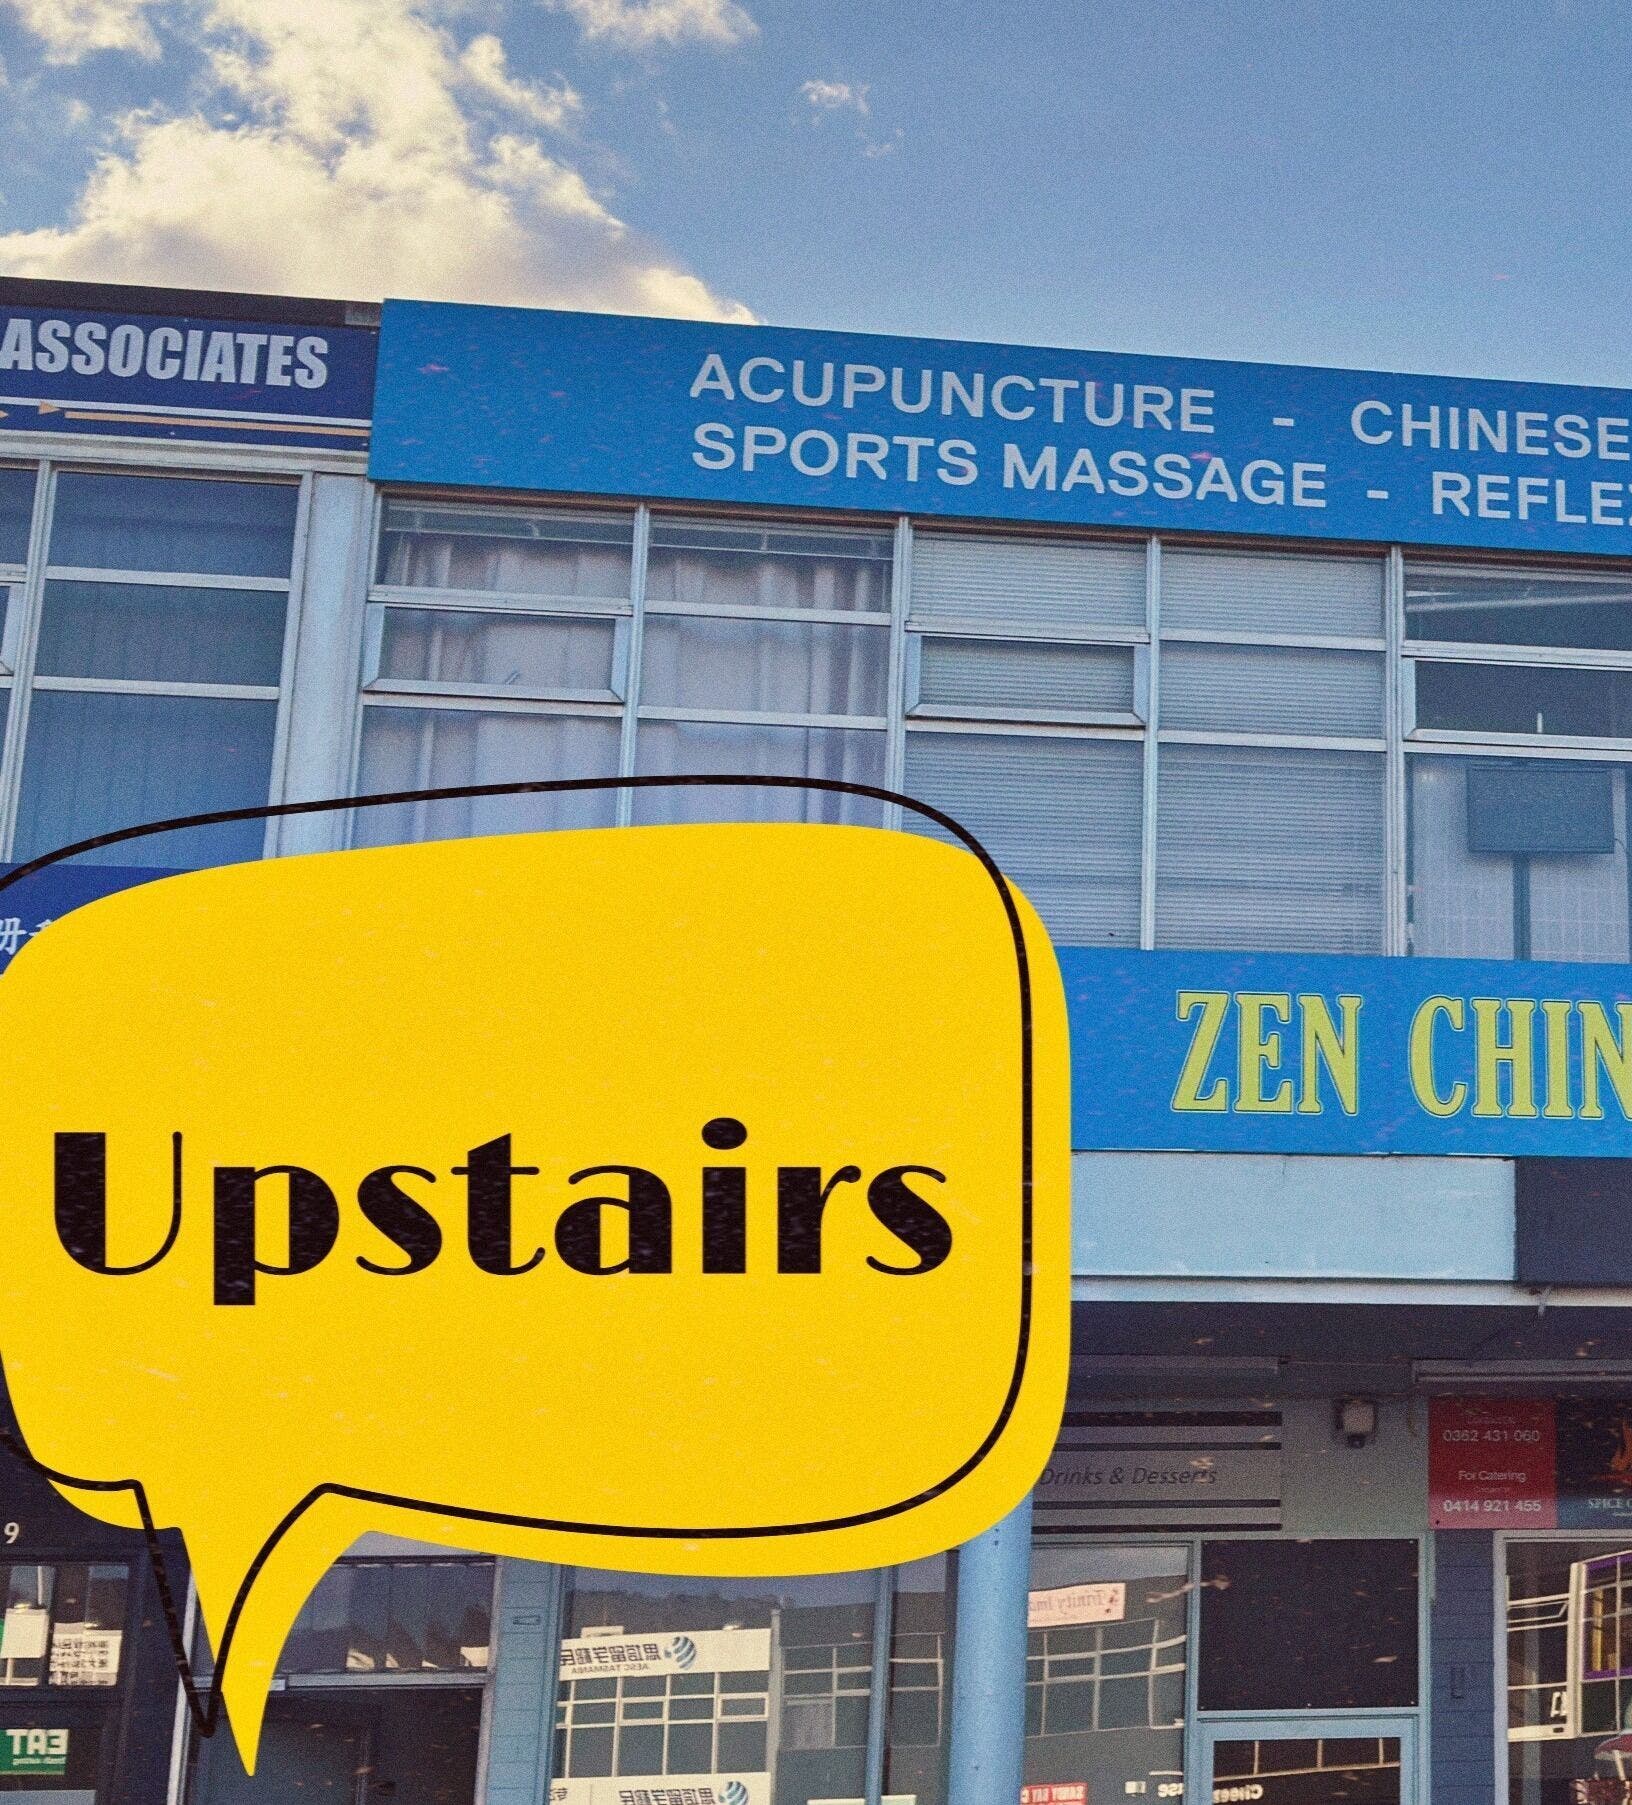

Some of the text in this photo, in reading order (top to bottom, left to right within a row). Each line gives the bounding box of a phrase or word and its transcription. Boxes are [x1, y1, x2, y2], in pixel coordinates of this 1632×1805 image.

[0, 318, 328, 389] ASSOCIATES
[689, 353, 1215, 434] ACUPUNCTURE
[1350, 400, 1631, 461] CHINESE
[691, 422, 979, 486] SPORTS
[1003, 443, 1327, 508] MASSAGE
[1170, 988, 1364, 1117] ZEN
[1483, 1430, 1508, 1442] 431
[1109, 1467, 1124, 1485] &
[1132, 1467, 1217, 1486] Desserts
[1458, 1470, 1528, 1483] For Catering
[1443, 1500, 1480, 1512] 0414
[1483, 1500, 1509, 1512] 921
